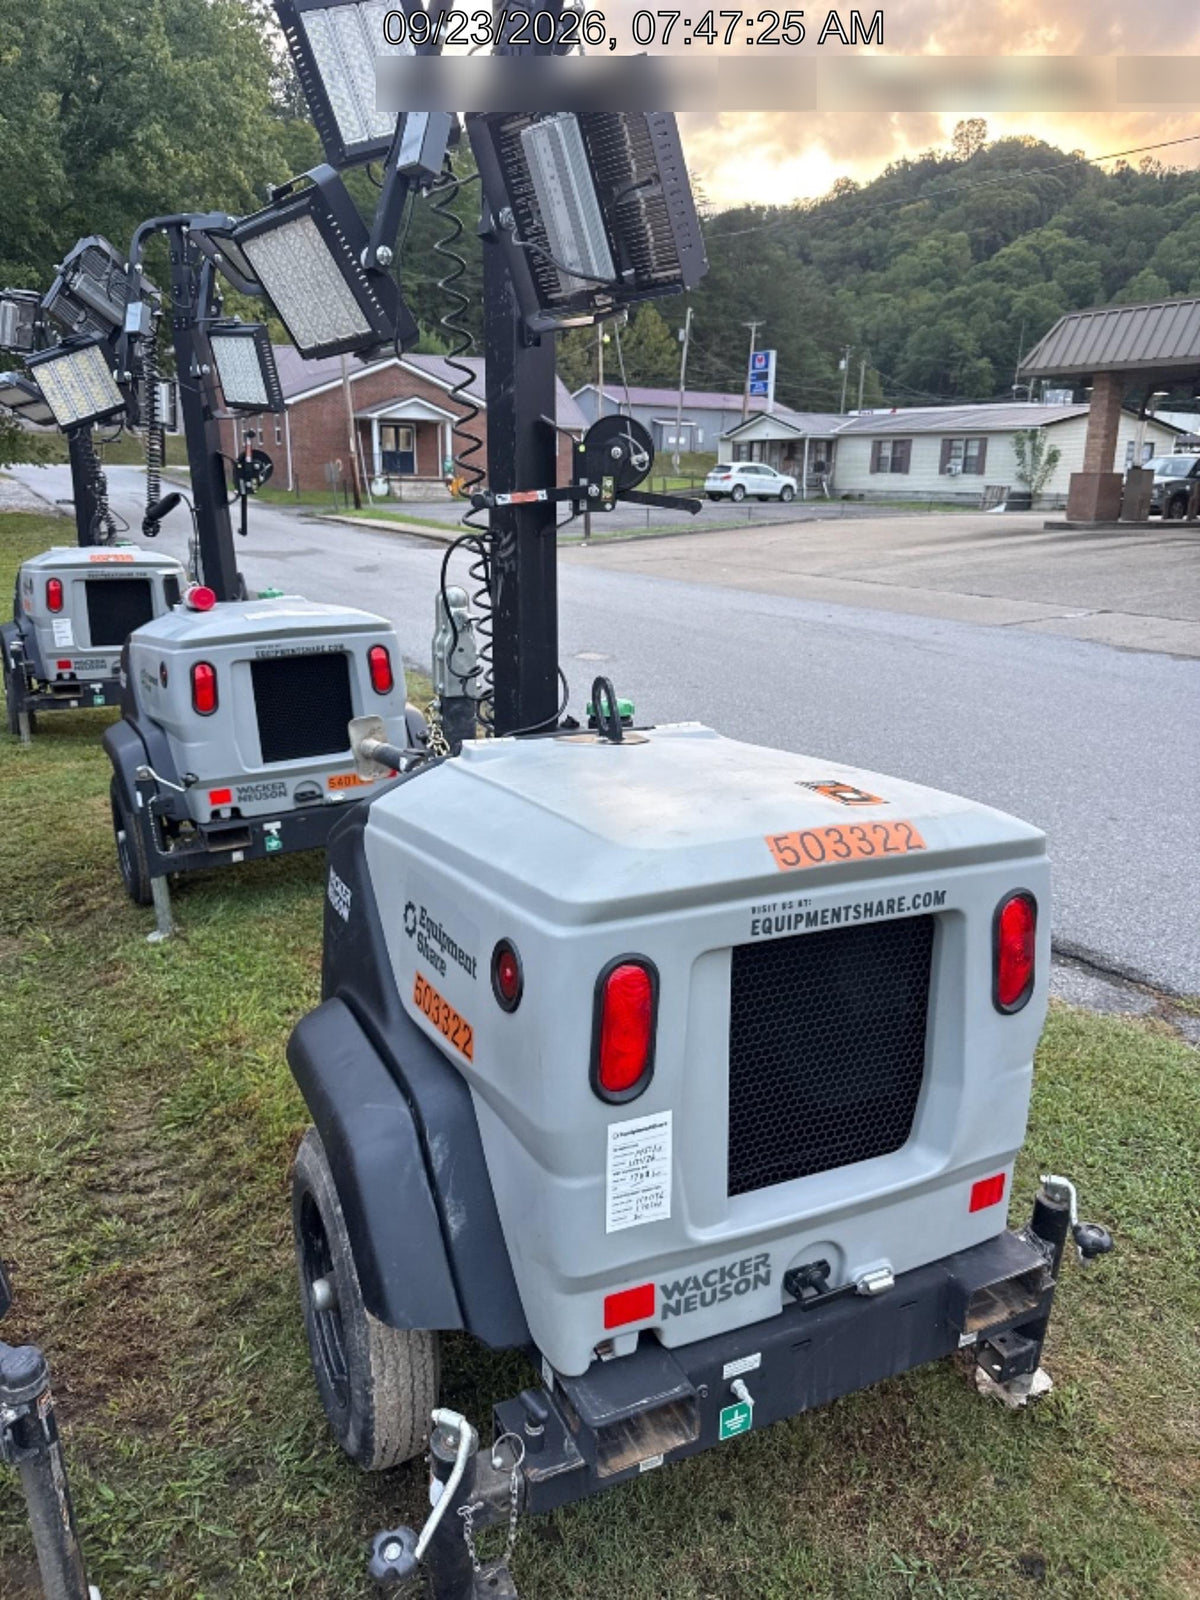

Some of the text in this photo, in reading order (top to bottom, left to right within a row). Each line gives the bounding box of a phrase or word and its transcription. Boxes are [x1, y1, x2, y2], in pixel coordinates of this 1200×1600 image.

[236, 782, 286, 794] WACKER
[238, 790, 288, 803] NEUSON
[328, 774, 374, 789] 5401
[773, 822, 923, 867] 503322
[751, 890, 947, 936] EQUIPMENTSHARE.COM
[416, 933, 447, 977] Share
[419, 905, 478, 980] Equipment
[414, 973, 474, 1062] 503322
[660, 1253, 772, 1300] WACKER
[661, 1270, 772, 1321] NEUSON
